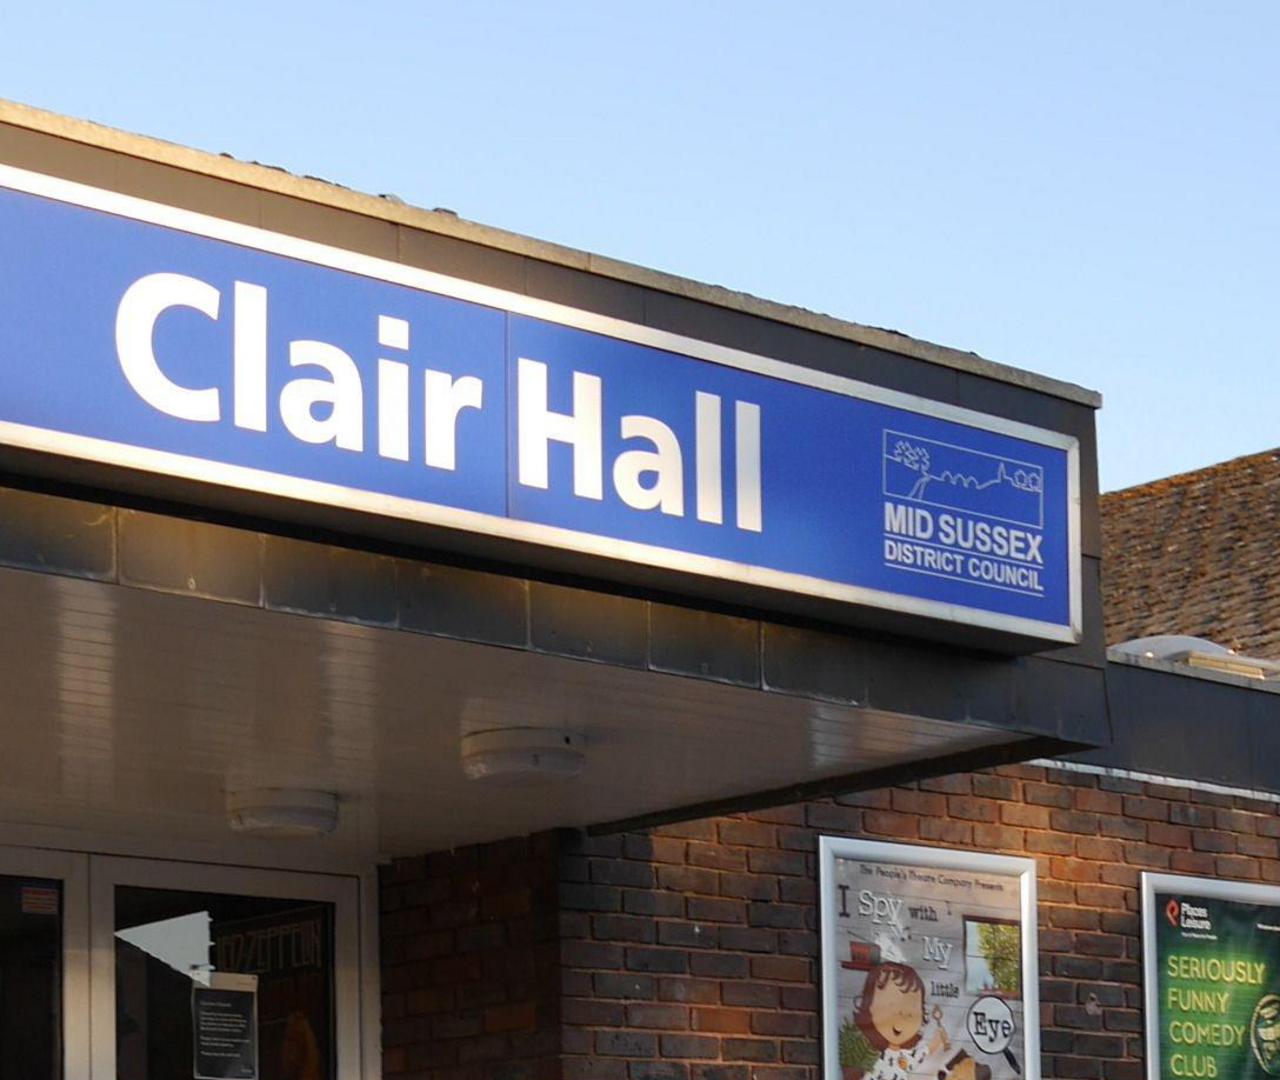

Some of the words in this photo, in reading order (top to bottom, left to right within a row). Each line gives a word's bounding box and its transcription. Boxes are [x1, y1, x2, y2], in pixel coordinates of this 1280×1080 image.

[115, 272, 482, 471] Clair
[518, 357, 762, 533] Hall
[884, 501, 934, 539] MID
[938, 514, 1043, 564] SUSSEX
[884, 539, 965, 573] DISTRICT
[968, 558, 1044, 591] COUNCIL
[858, 889, 903, 926] Spy
[908, 904, 938, 922] with
[923, 935, 954, 971] My
[1167, 955, 1266, 985] SERIOUSLY
[1167, 988, 1230, 1013] FUNNY
[973, 1011, 1012, 1043] Eye
[1169, 1020, 1246, 1047] COMEDY
[1170, 1053, 1218, 1078] CLUB
